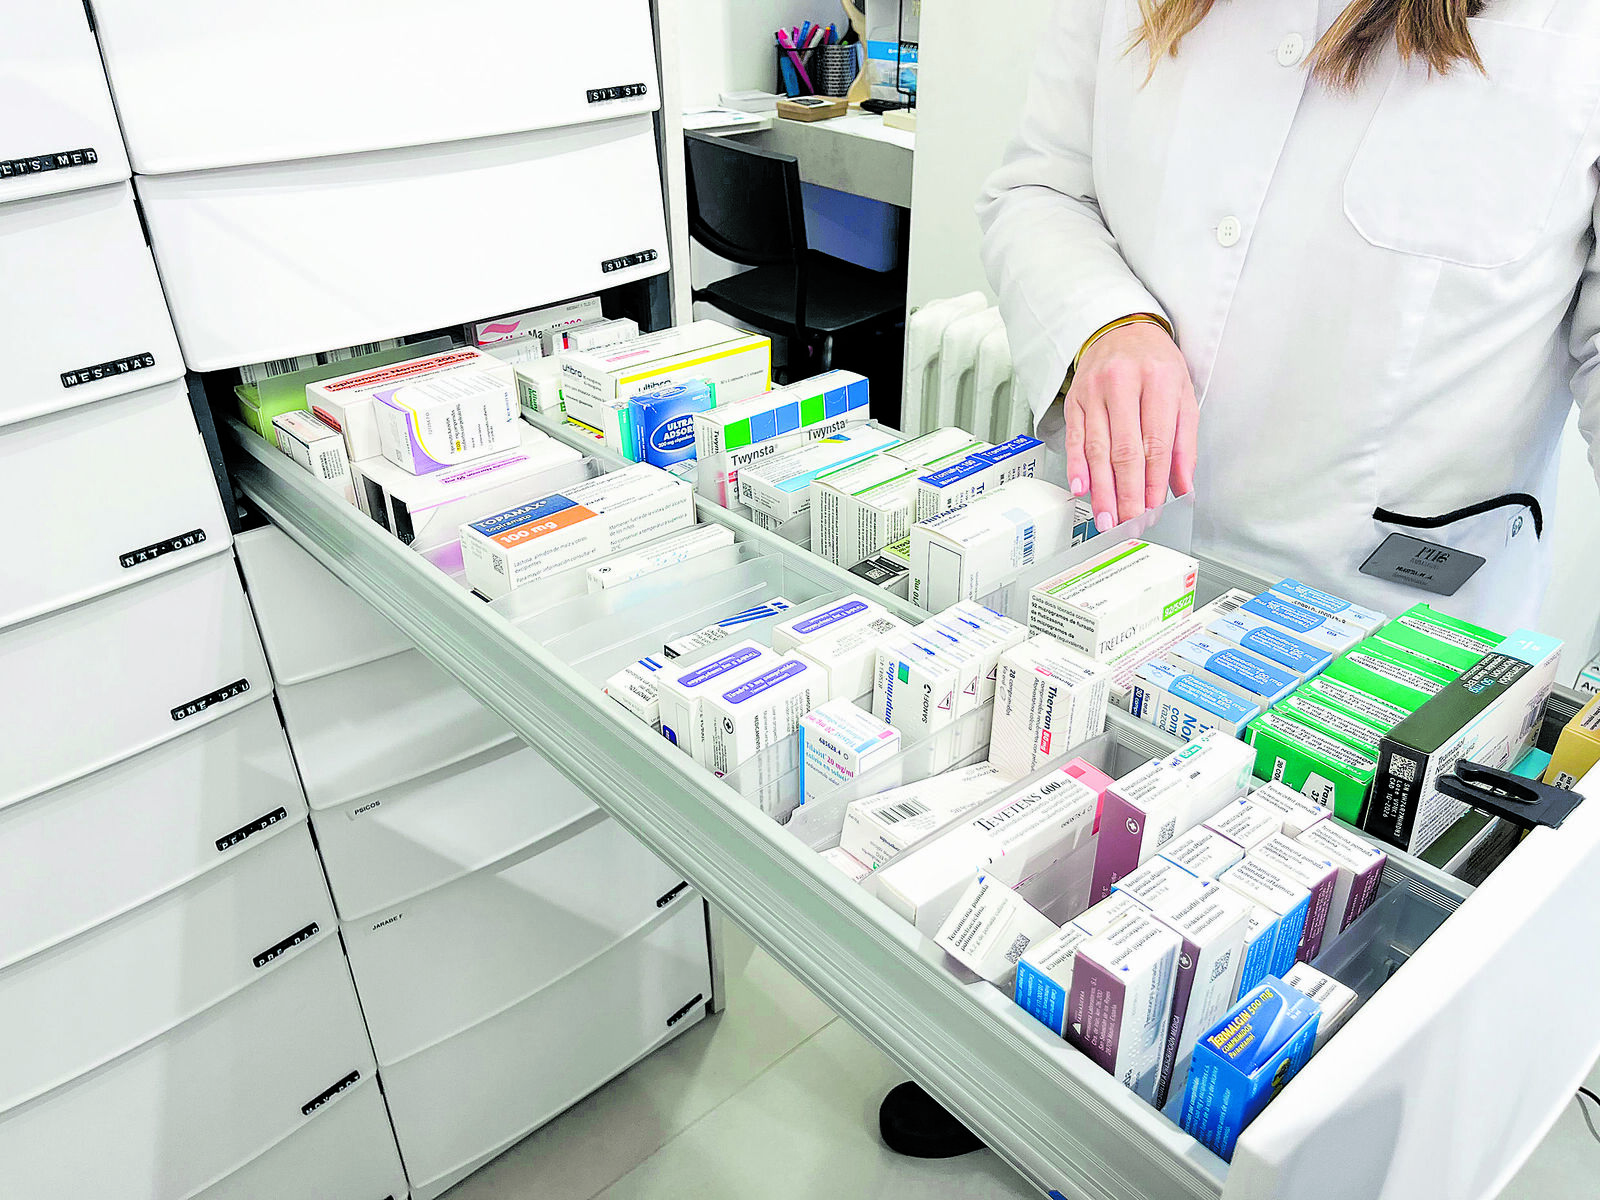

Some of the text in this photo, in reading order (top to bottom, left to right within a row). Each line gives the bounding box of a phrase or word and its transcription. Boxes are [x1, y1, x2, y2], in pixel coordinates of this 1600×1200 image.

[663, 426, 694, 441] ADSOR
[667, 416, 693, 432] ULTRA
[807, 419, 847, 441] Twynsta
[731, 445, 775, 467] Twynsta
[500, 521, 558, 543] 100 mg
[885, 661, 896, 725] omprimidos
[921, 694, 931, 724] SANOFI
[1044, 686, 1058, 730] Thervan
[1180, 713, 1198, 742] Nor
[1040, 781, 1062, 796] 600
[354, 800, 381, 816] PSICOS
[1207, 1009, 1252, 1051] TERMALGIN
[1247, 998, 1263, 1016] 500
[1259, 987, 1275, 1005] mg
